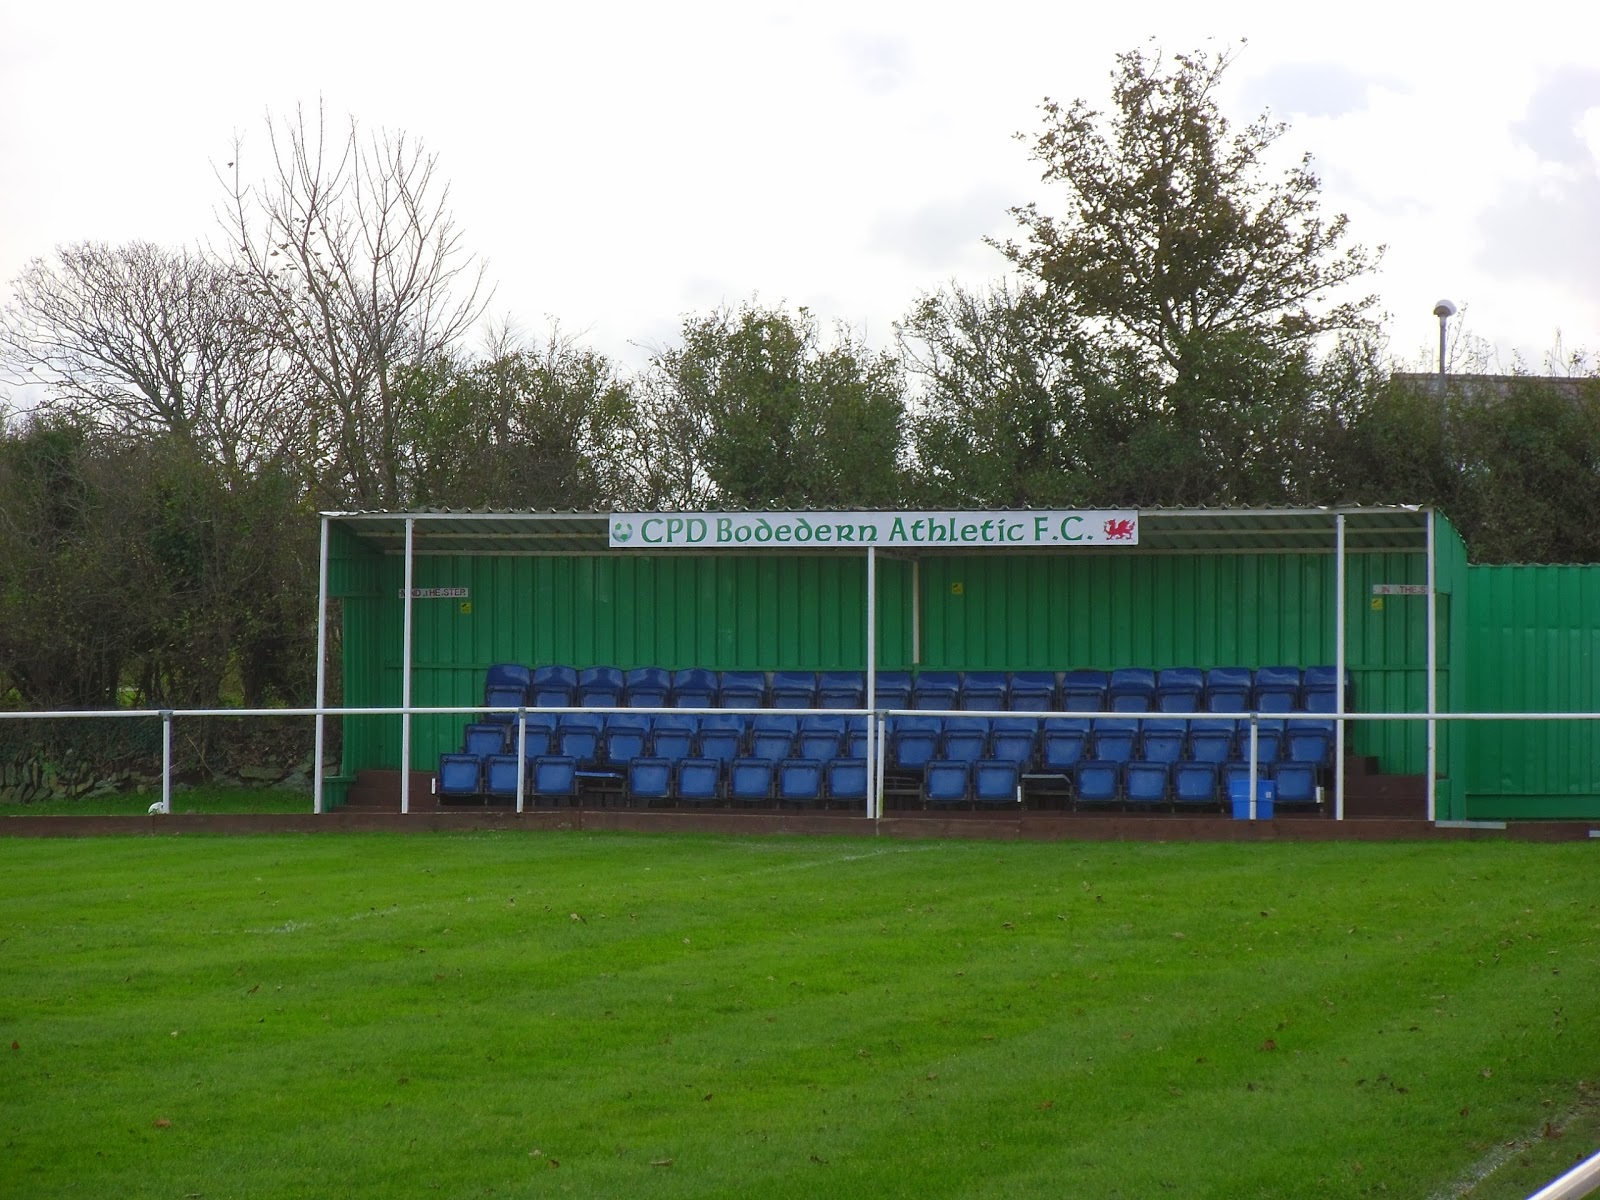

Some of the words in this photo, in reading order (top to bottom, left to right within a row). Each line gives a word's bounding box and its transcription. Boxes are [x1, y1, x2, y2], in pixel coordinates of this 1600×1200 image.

[641, 518, 707, 543] CPD
[716, 517, 878, 542] Bodedern
[889, 516, 1024, 541] Athletic
[1034, 516, 1093, 541] F.C.
